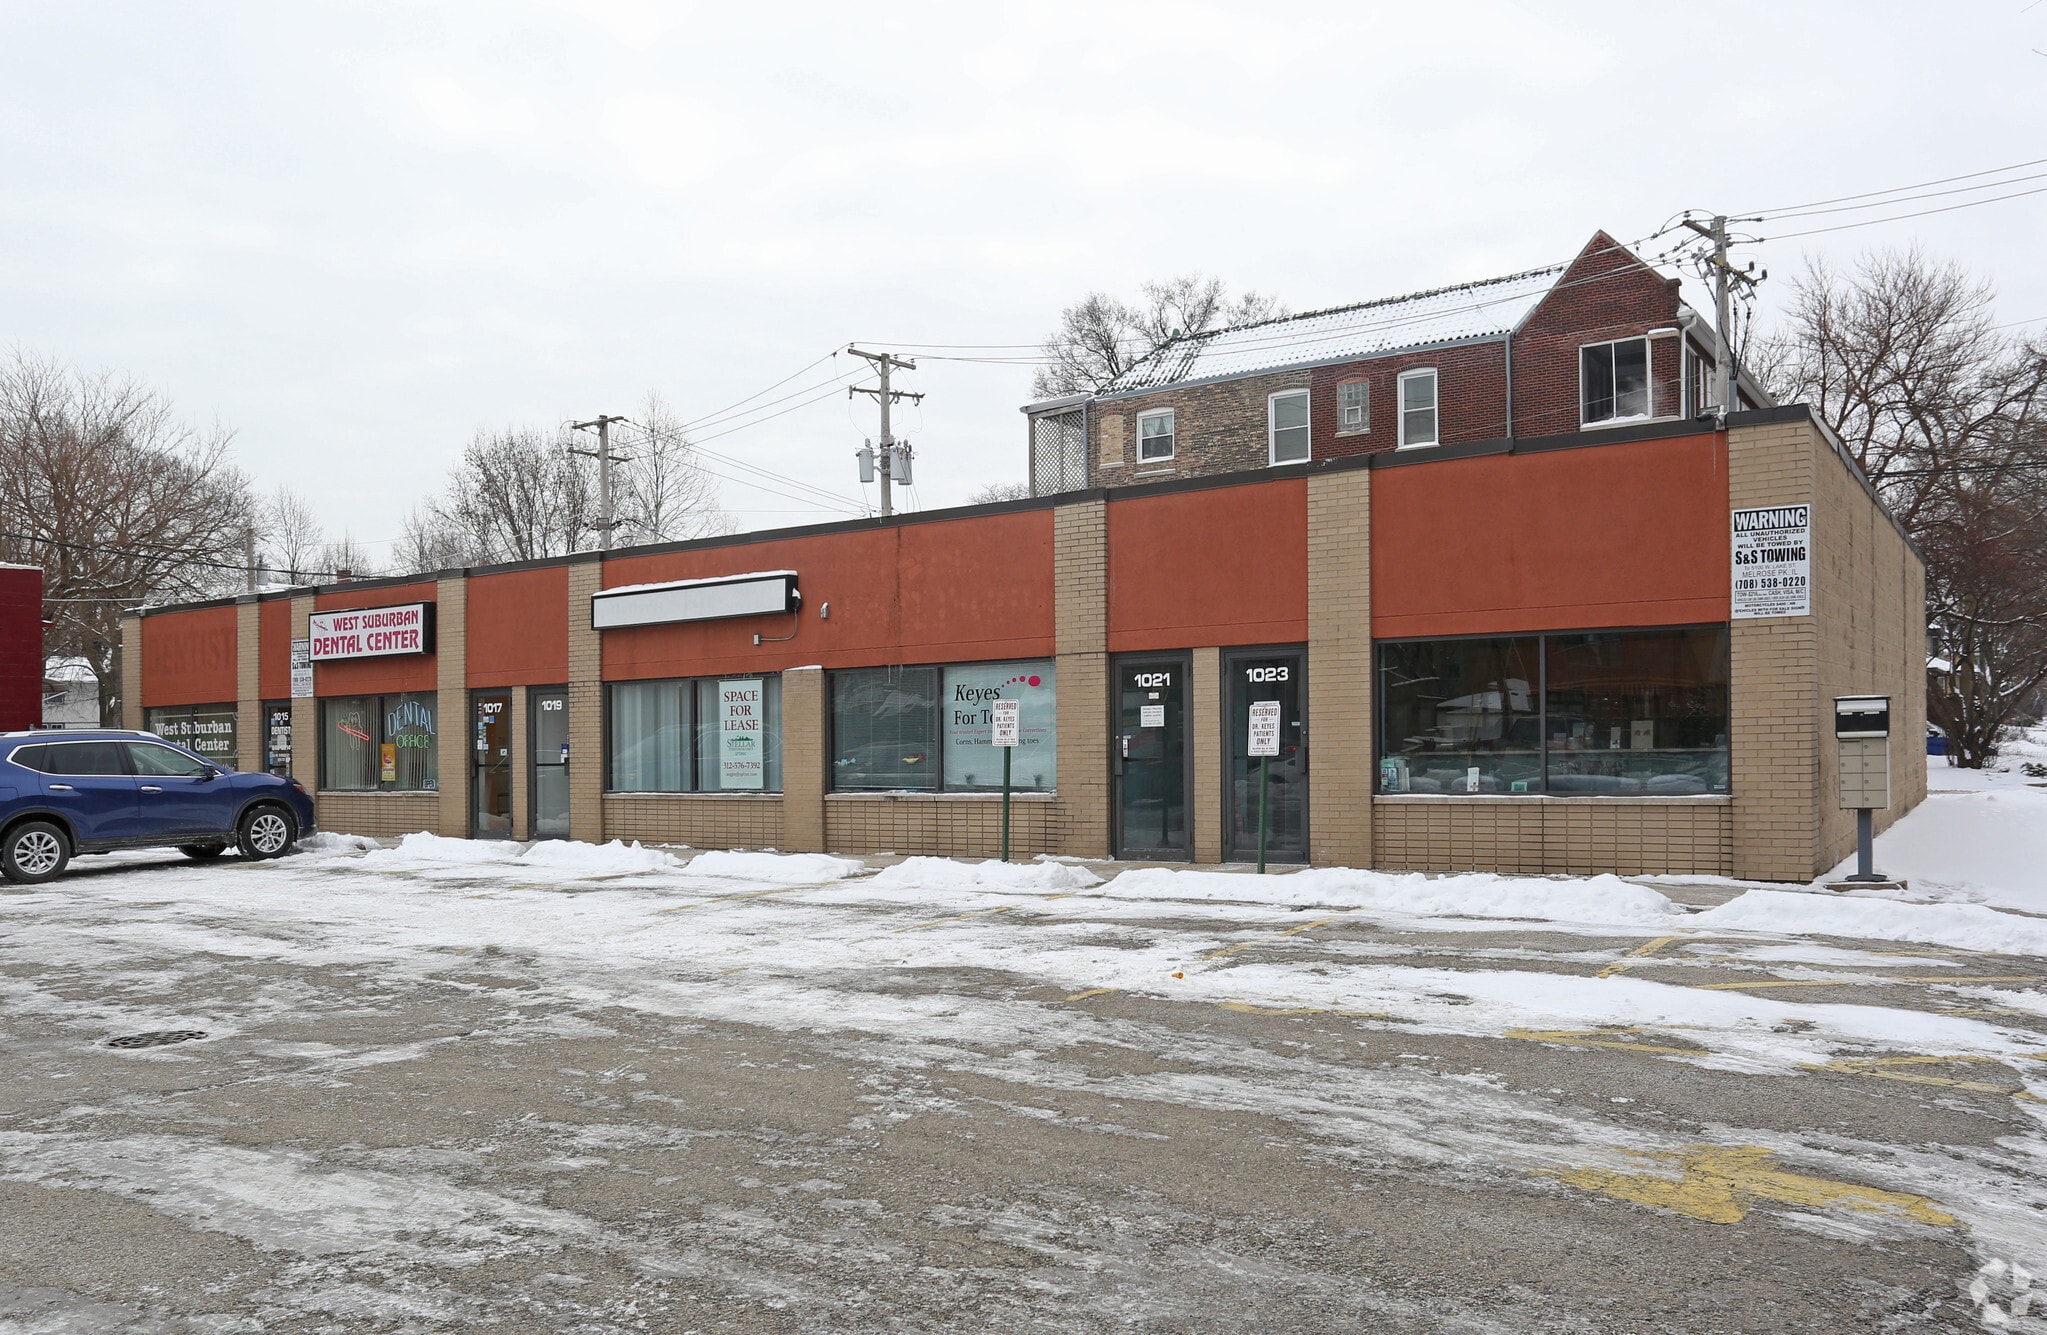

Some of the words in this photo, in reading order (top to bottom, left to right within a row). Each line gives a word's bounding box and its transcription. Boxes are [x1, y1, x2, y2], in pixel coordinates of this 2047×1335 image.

[1736, 508, 1806, 530] WARNING
[1750, 528, 1805, 537] UNAUTHORIZED
[1736, 550, 1758, 564] S&S
[1760, 547, 1806, 563] TOWING
[1736, 579, 1758, 590] (708)
[1761, 576, 1806, 588] 538-0220
[333, 616, 359, 631] WEST
[362, 610, 418, 629] SUBURBAN
[314, 635, 362, 655] DENTAL
[367, 629, 419, 651] CENTER
[1134, 673, 1170, 687] 1021
[1246, 667, 1288, 682] 1023
[724, 690, 758, 702] SPACE
[955, 684, 1000, 706] Keyes
[483, 703, 502, 713] 1017
[542, 700, 562, 711] 1019
[730, 705, 752, 716] FOR
[274, 712, 288, 720] 1015
[388, 701, 436, 736] DENTAL
[954, 711, 976, 725] For
[1252, 708, 1277, 717] RESERVED
[155, 723, 178, 736] West
[181, 721, 232, 734] Suburban
[271, 726, 291, 735] DENTIST
[724, 720, 758, 730] LEASE
[195, 738, 229, 751] Center
[396, 735, 430, 748] OFFICE
[727, 739, 755, 748] STELLAR
